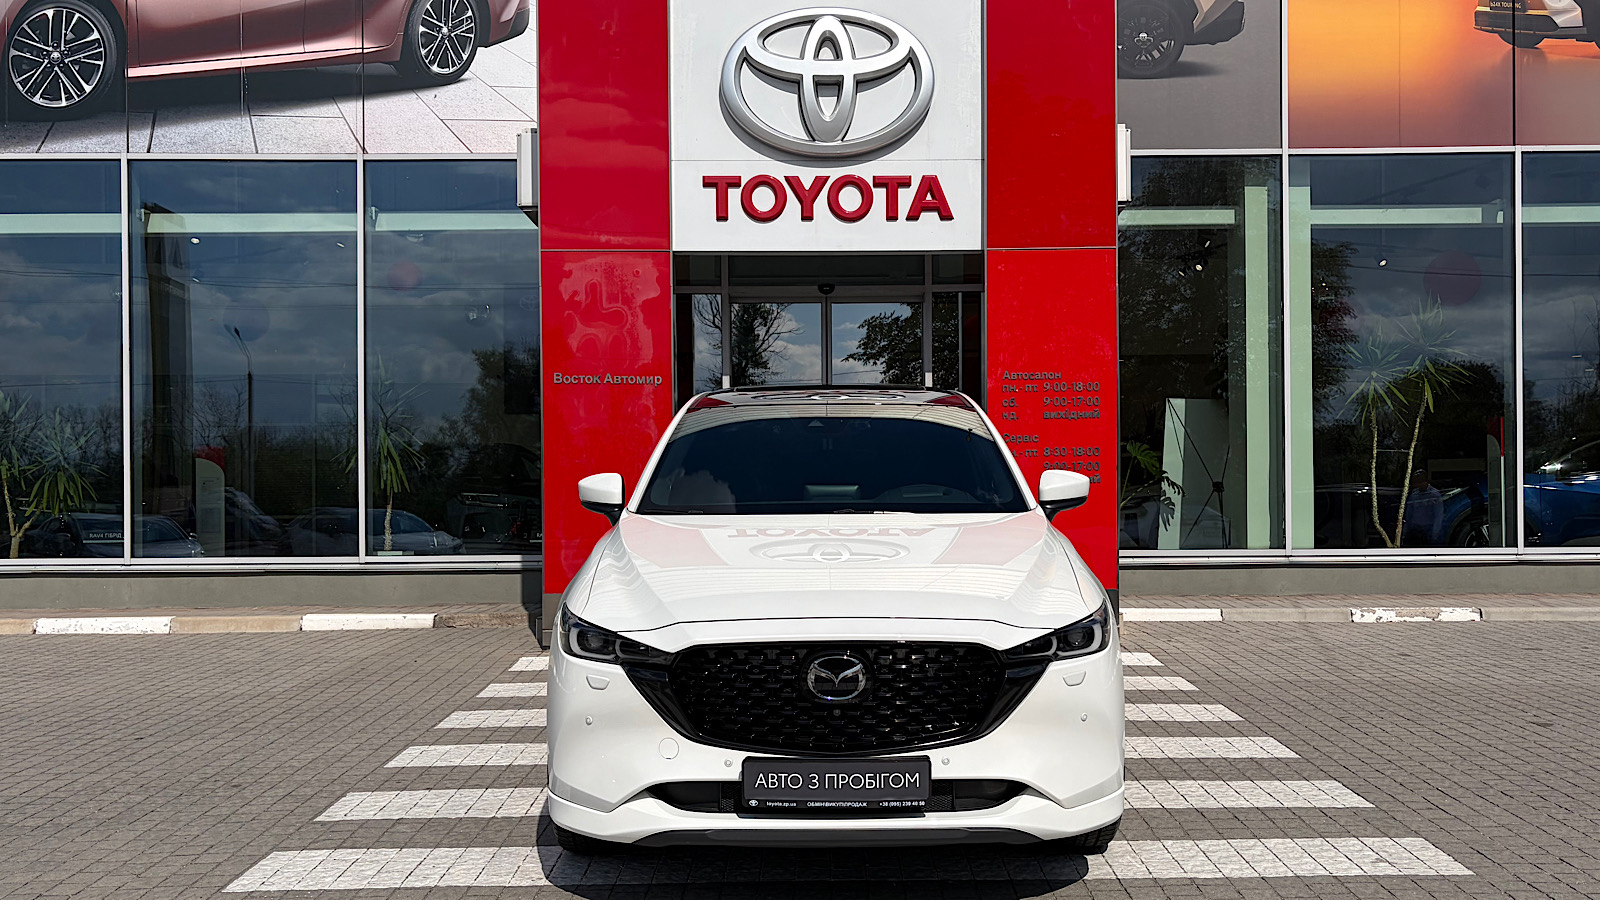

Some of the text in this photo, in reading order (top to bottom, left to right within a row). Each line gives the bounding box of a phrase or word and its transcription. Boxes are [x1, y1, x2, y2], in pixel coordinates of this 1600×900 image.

[702, 174, 954, 223] TOYOTA
[553, 372, 663, 388] Восток Автомир
[1003, 371, 1062, 380] Автосалон
[1043, 382, 1100, 391] 9:00-18:00
[1002, 397, 1100, 407] сб. 9:00-17:00
[1002, 409, 1100, 420] нд. вихідний
[1002, 433, 1039, 444] Сервіс
[1043, 461, 1100, 471] 9:00-17:00
[754, 773, 803, 789] АВТО
[825, 772, 920, 789] ПРОБІГОМ
